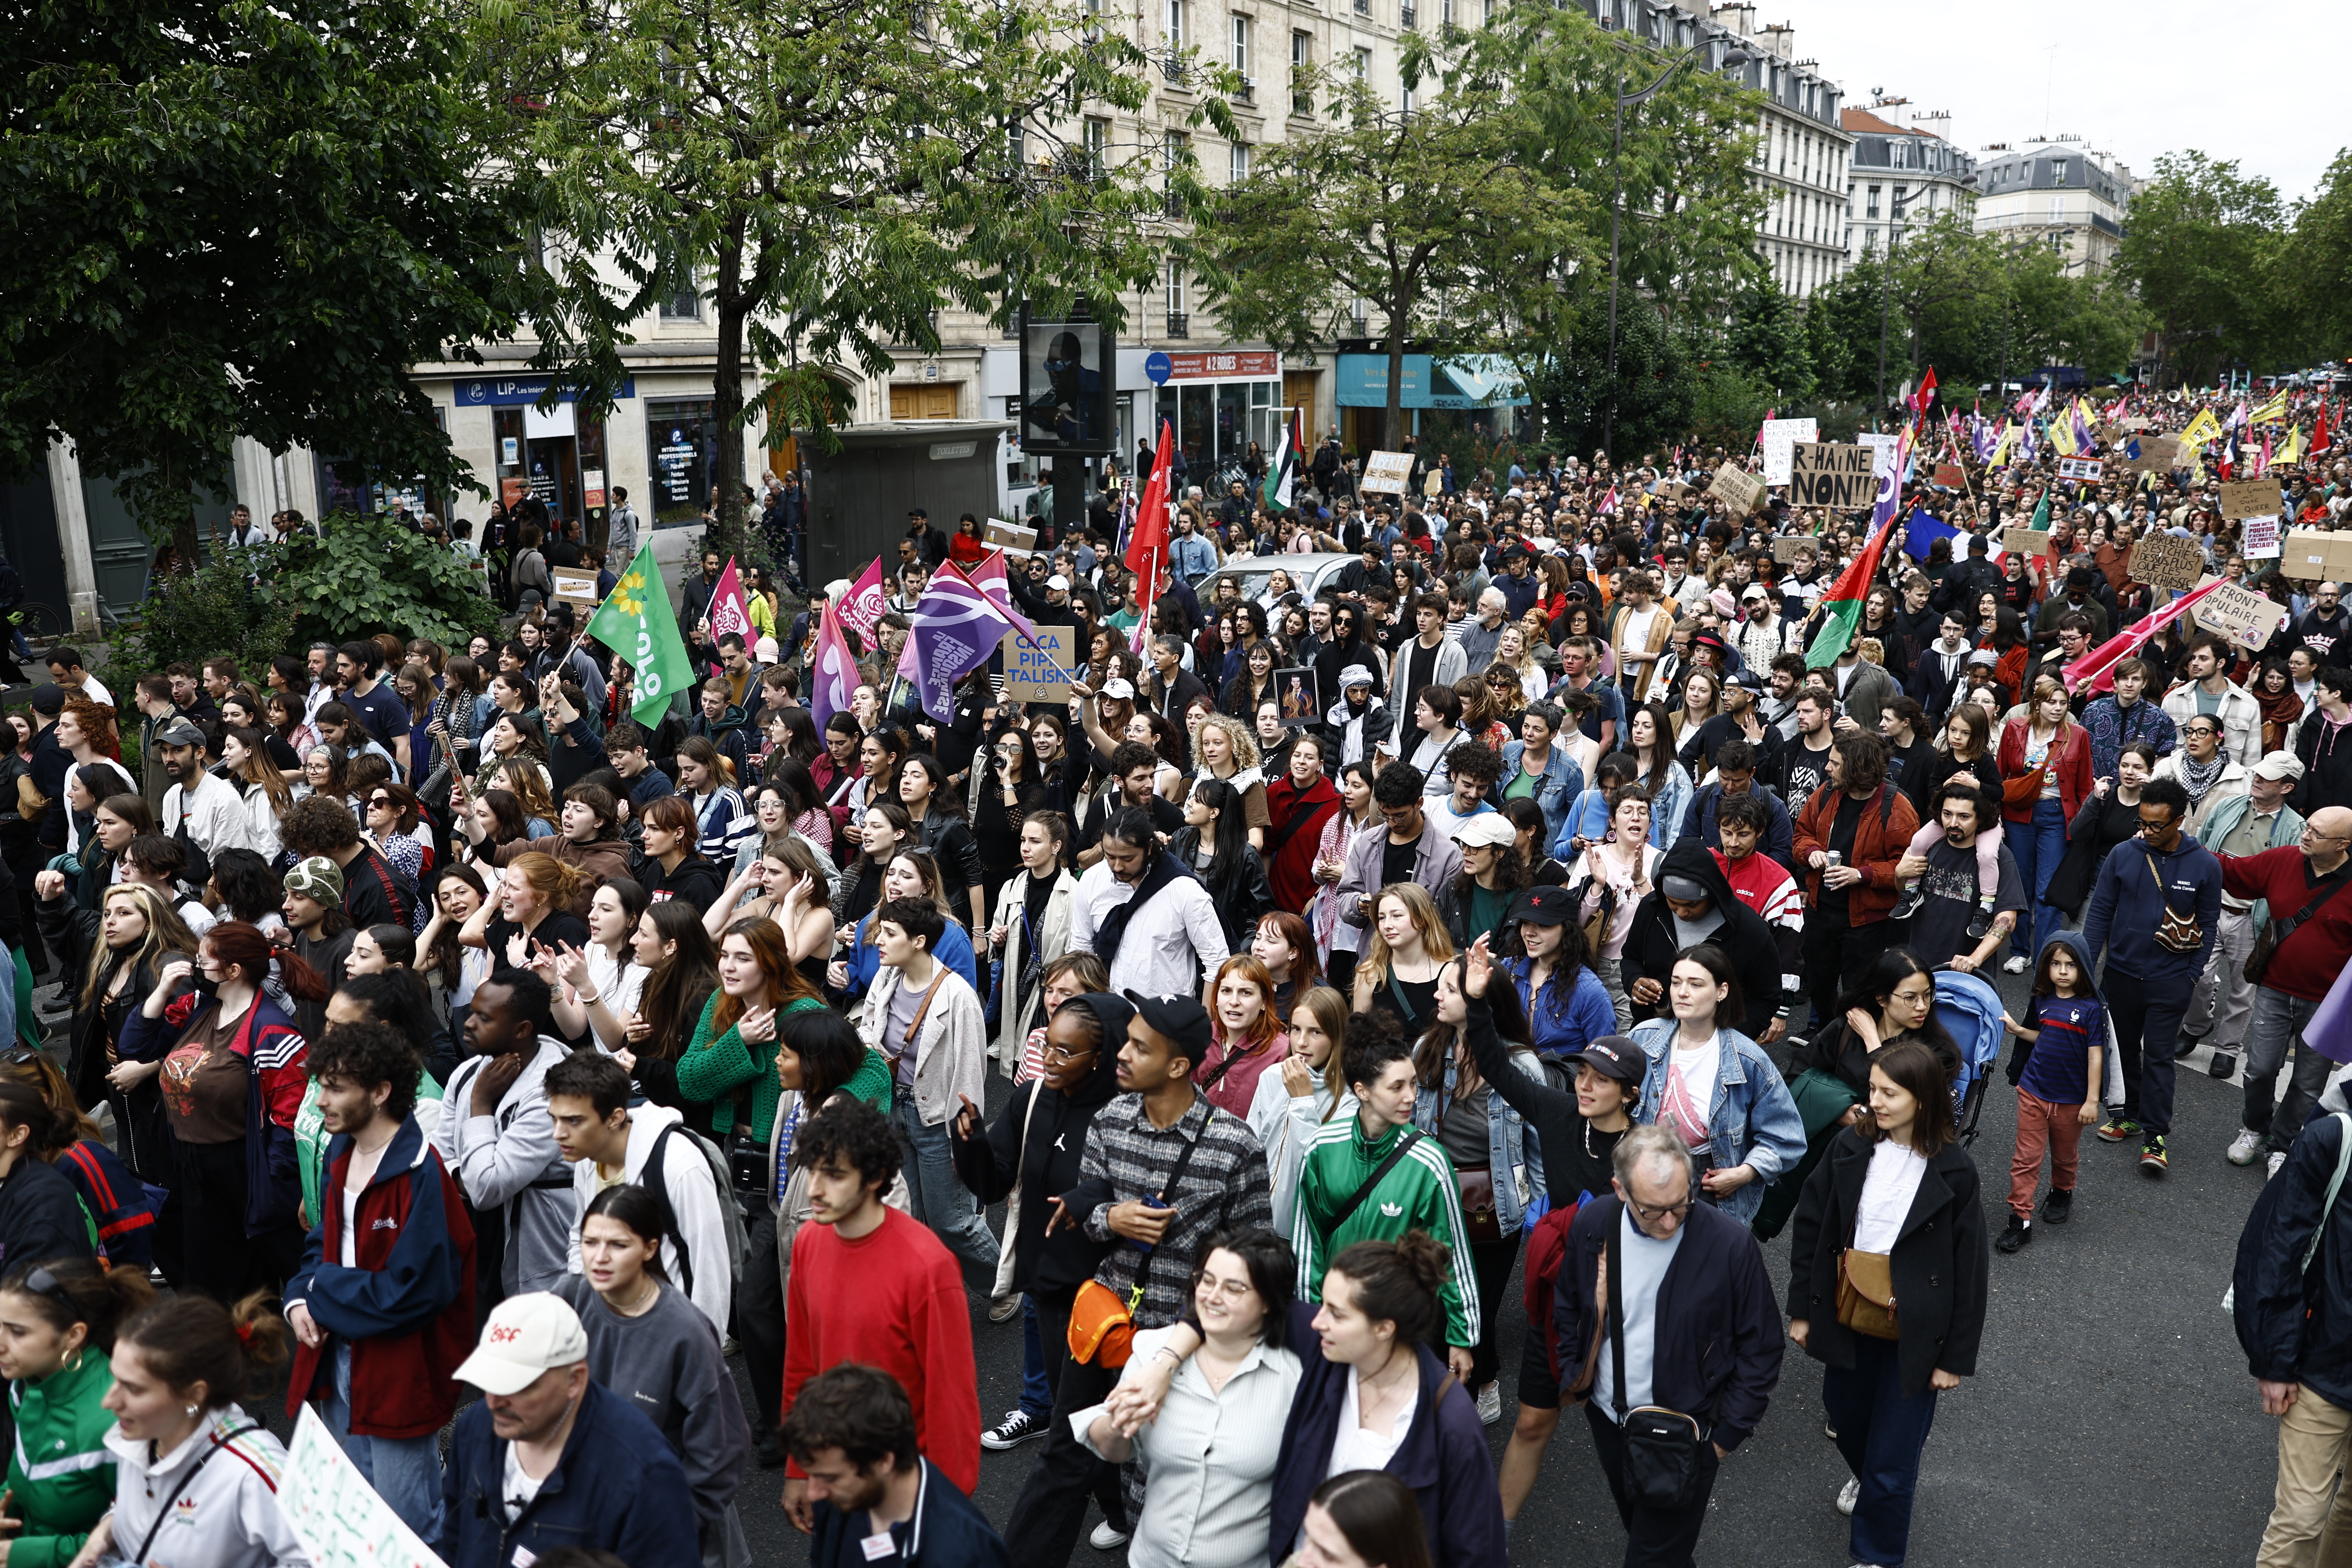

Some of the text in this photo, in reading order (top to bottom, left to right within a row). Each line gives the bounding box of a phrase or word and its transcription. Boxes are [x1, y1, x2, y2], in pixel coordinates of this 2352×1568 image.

[1206, 356, 1211, 371] A
[1212, 356, 1217, 370] 2
[1365, 368, 1378, 376] Vin
[1401, 368, 1417, 377] arée
[497, 382, 515, 396] LIP
[1765, 420, 1797, 430] CHIENS
[1765, 430, 1798, 439] MACRON
[658, 452, 697, 460] PROFESSIONNELS
[937, 445, 971, 455] TOILETTES
[1370, 452, 1409, 472] LIBERTÉ
[1367, 469, 1401, 480] JE CRIE
[1380, 479, 1403, 494] NOM
[1721, 475, 1748, 497] ARRIERE
[1719, 492, 1740, 509] ARYENNE
[2244, 503, 2270, 514] QUEER
[2249, 526, 2275, 534] POUVOIR
[2142, 542, 2168, 554] S'EST
[2146, 532, 2194, 550] BARDELLA
[2137, 561, 2181, 576] QUE LES
[2169, 557, 2195, 571] PLUS
[2219, 585, 2261, 610] FRONT
[1015, 635, 1060, 650] CACA
[1020, 652, 1053, 667] PIPI
[1007, 668, 1074, 684] TALISME
[1736, 889, 1754, 897] adidas
